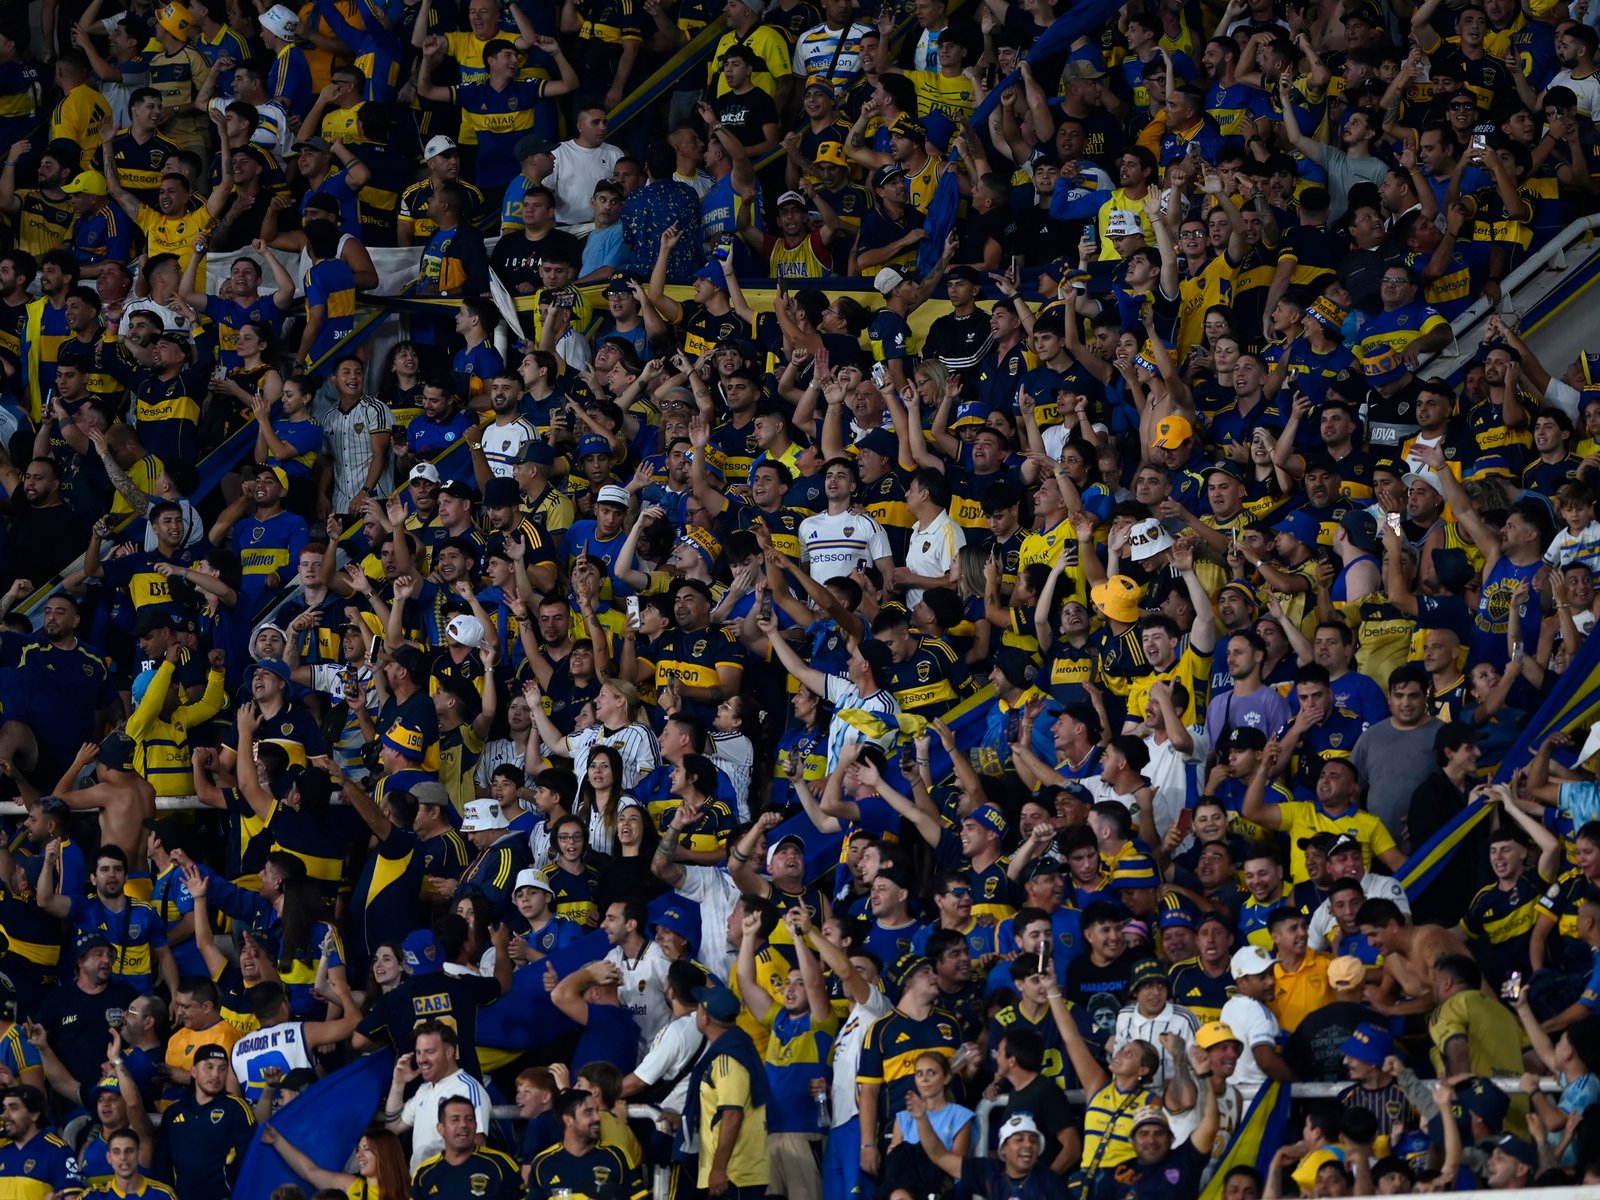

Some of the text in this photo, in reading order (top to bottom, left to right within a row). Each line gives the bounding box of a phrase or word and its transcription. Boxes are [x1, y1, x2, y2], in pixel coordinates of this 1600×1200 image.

[810, 59, 852, 68] betson
[161, 89, 181, 97] sson
[484, 116, 515, 126] QATAR
[1436, 277, 1470, 294] betsson
[1371, 428, 1396, 441] BBVA
[960, 506, 983, 519] BBV
[773, 541, 795, 551] sson
[241, 552, 275, 567] uilmes
[1364, 626, 1413, 636] betsson
[658, 666, 699, 682] beson
[1056, 666, 1090, 674] MEGATO
[407, 735, 423, 747] 190
[803, 740, 819, 758] LOVE
[984, 808, 1006, 832] 1905
[415, 997, 451, 1013] CABJ
[236, 1035, 269, 1057] JUGADOR
[285, 1029, 296, 1043] 12
